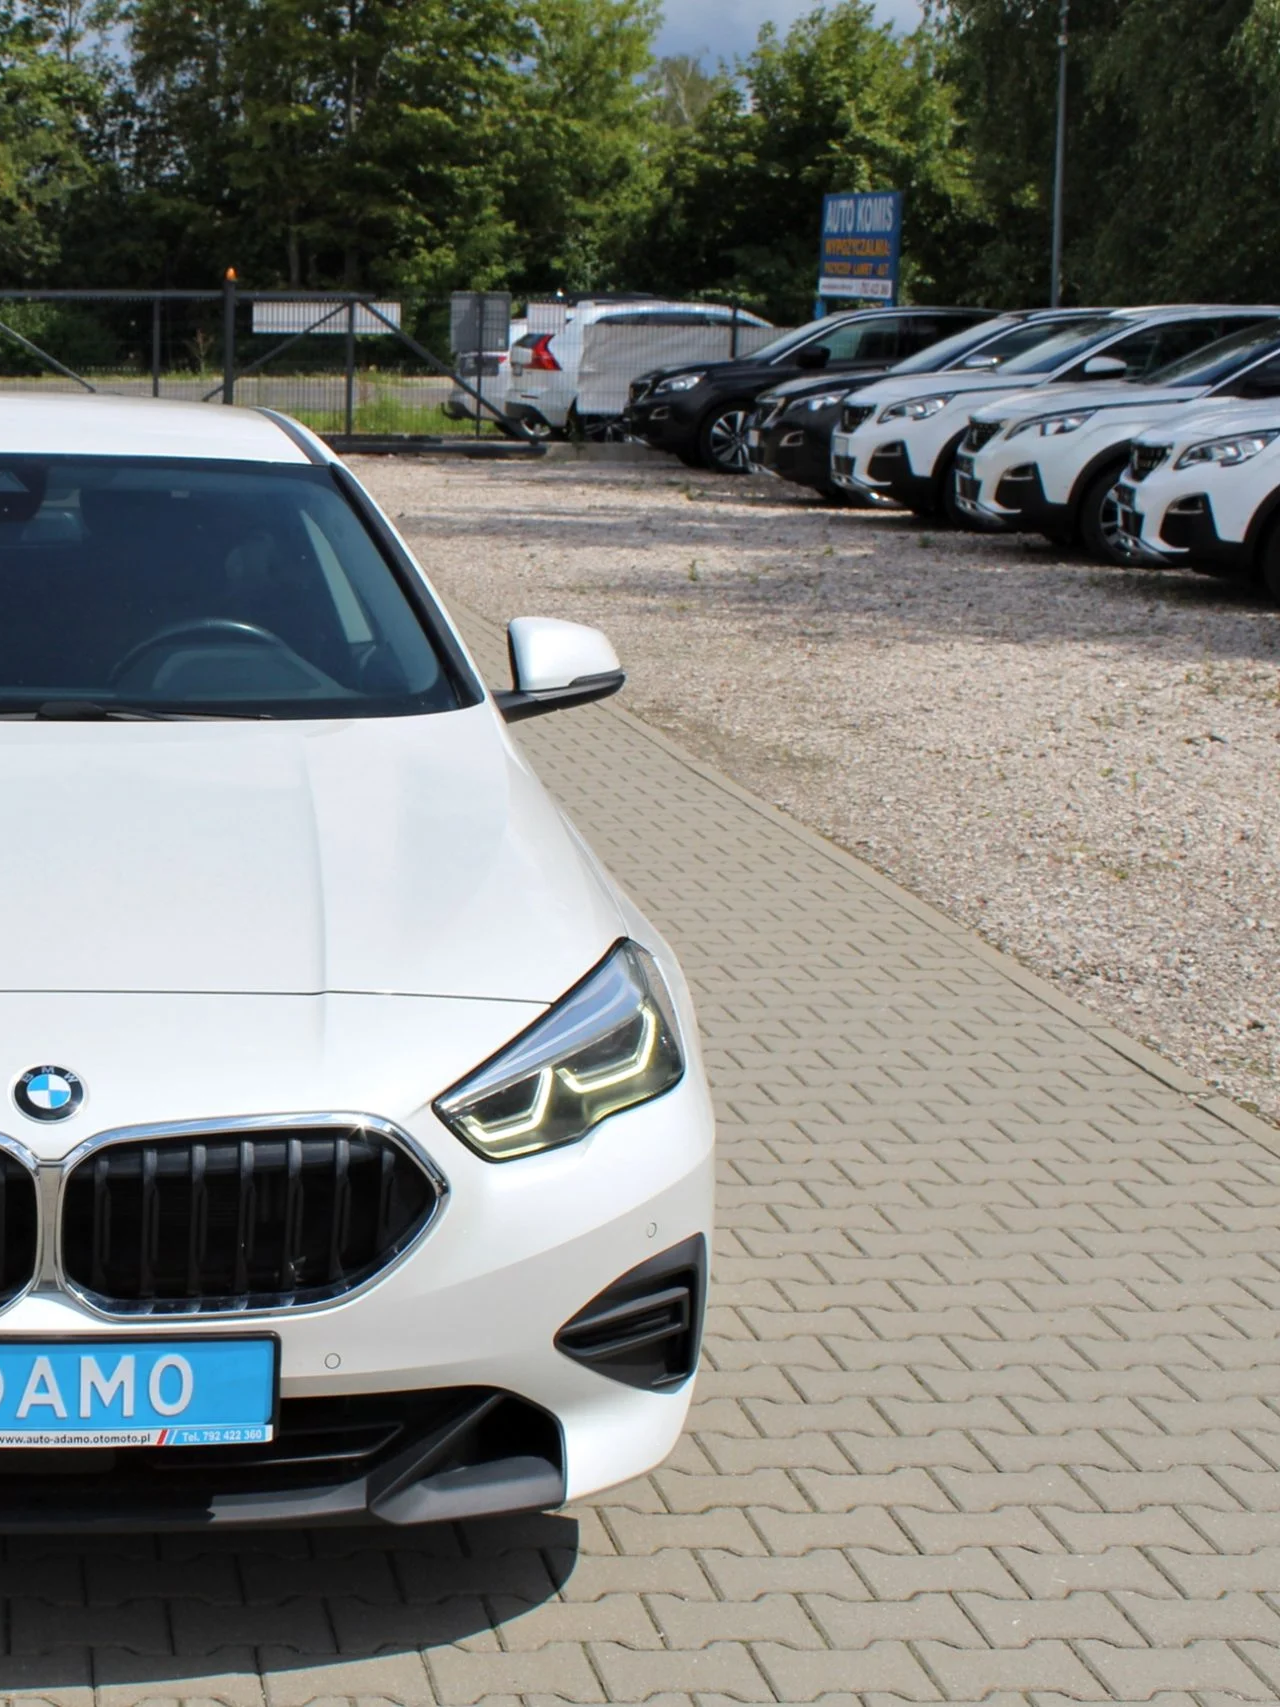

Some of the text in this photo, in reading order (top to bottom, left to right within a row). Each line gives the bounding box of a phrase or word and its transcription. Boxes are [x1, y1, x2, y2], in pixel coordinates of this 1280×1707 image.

[824, 196, 894, 233] AUTO KOMIS
[22, 1066, 80, 1083] BMW
[182, 1432, 200, 1442] Tel.
[203, 1431, 221, 1441] 792
[223, 1430, 241, 1440] 422
